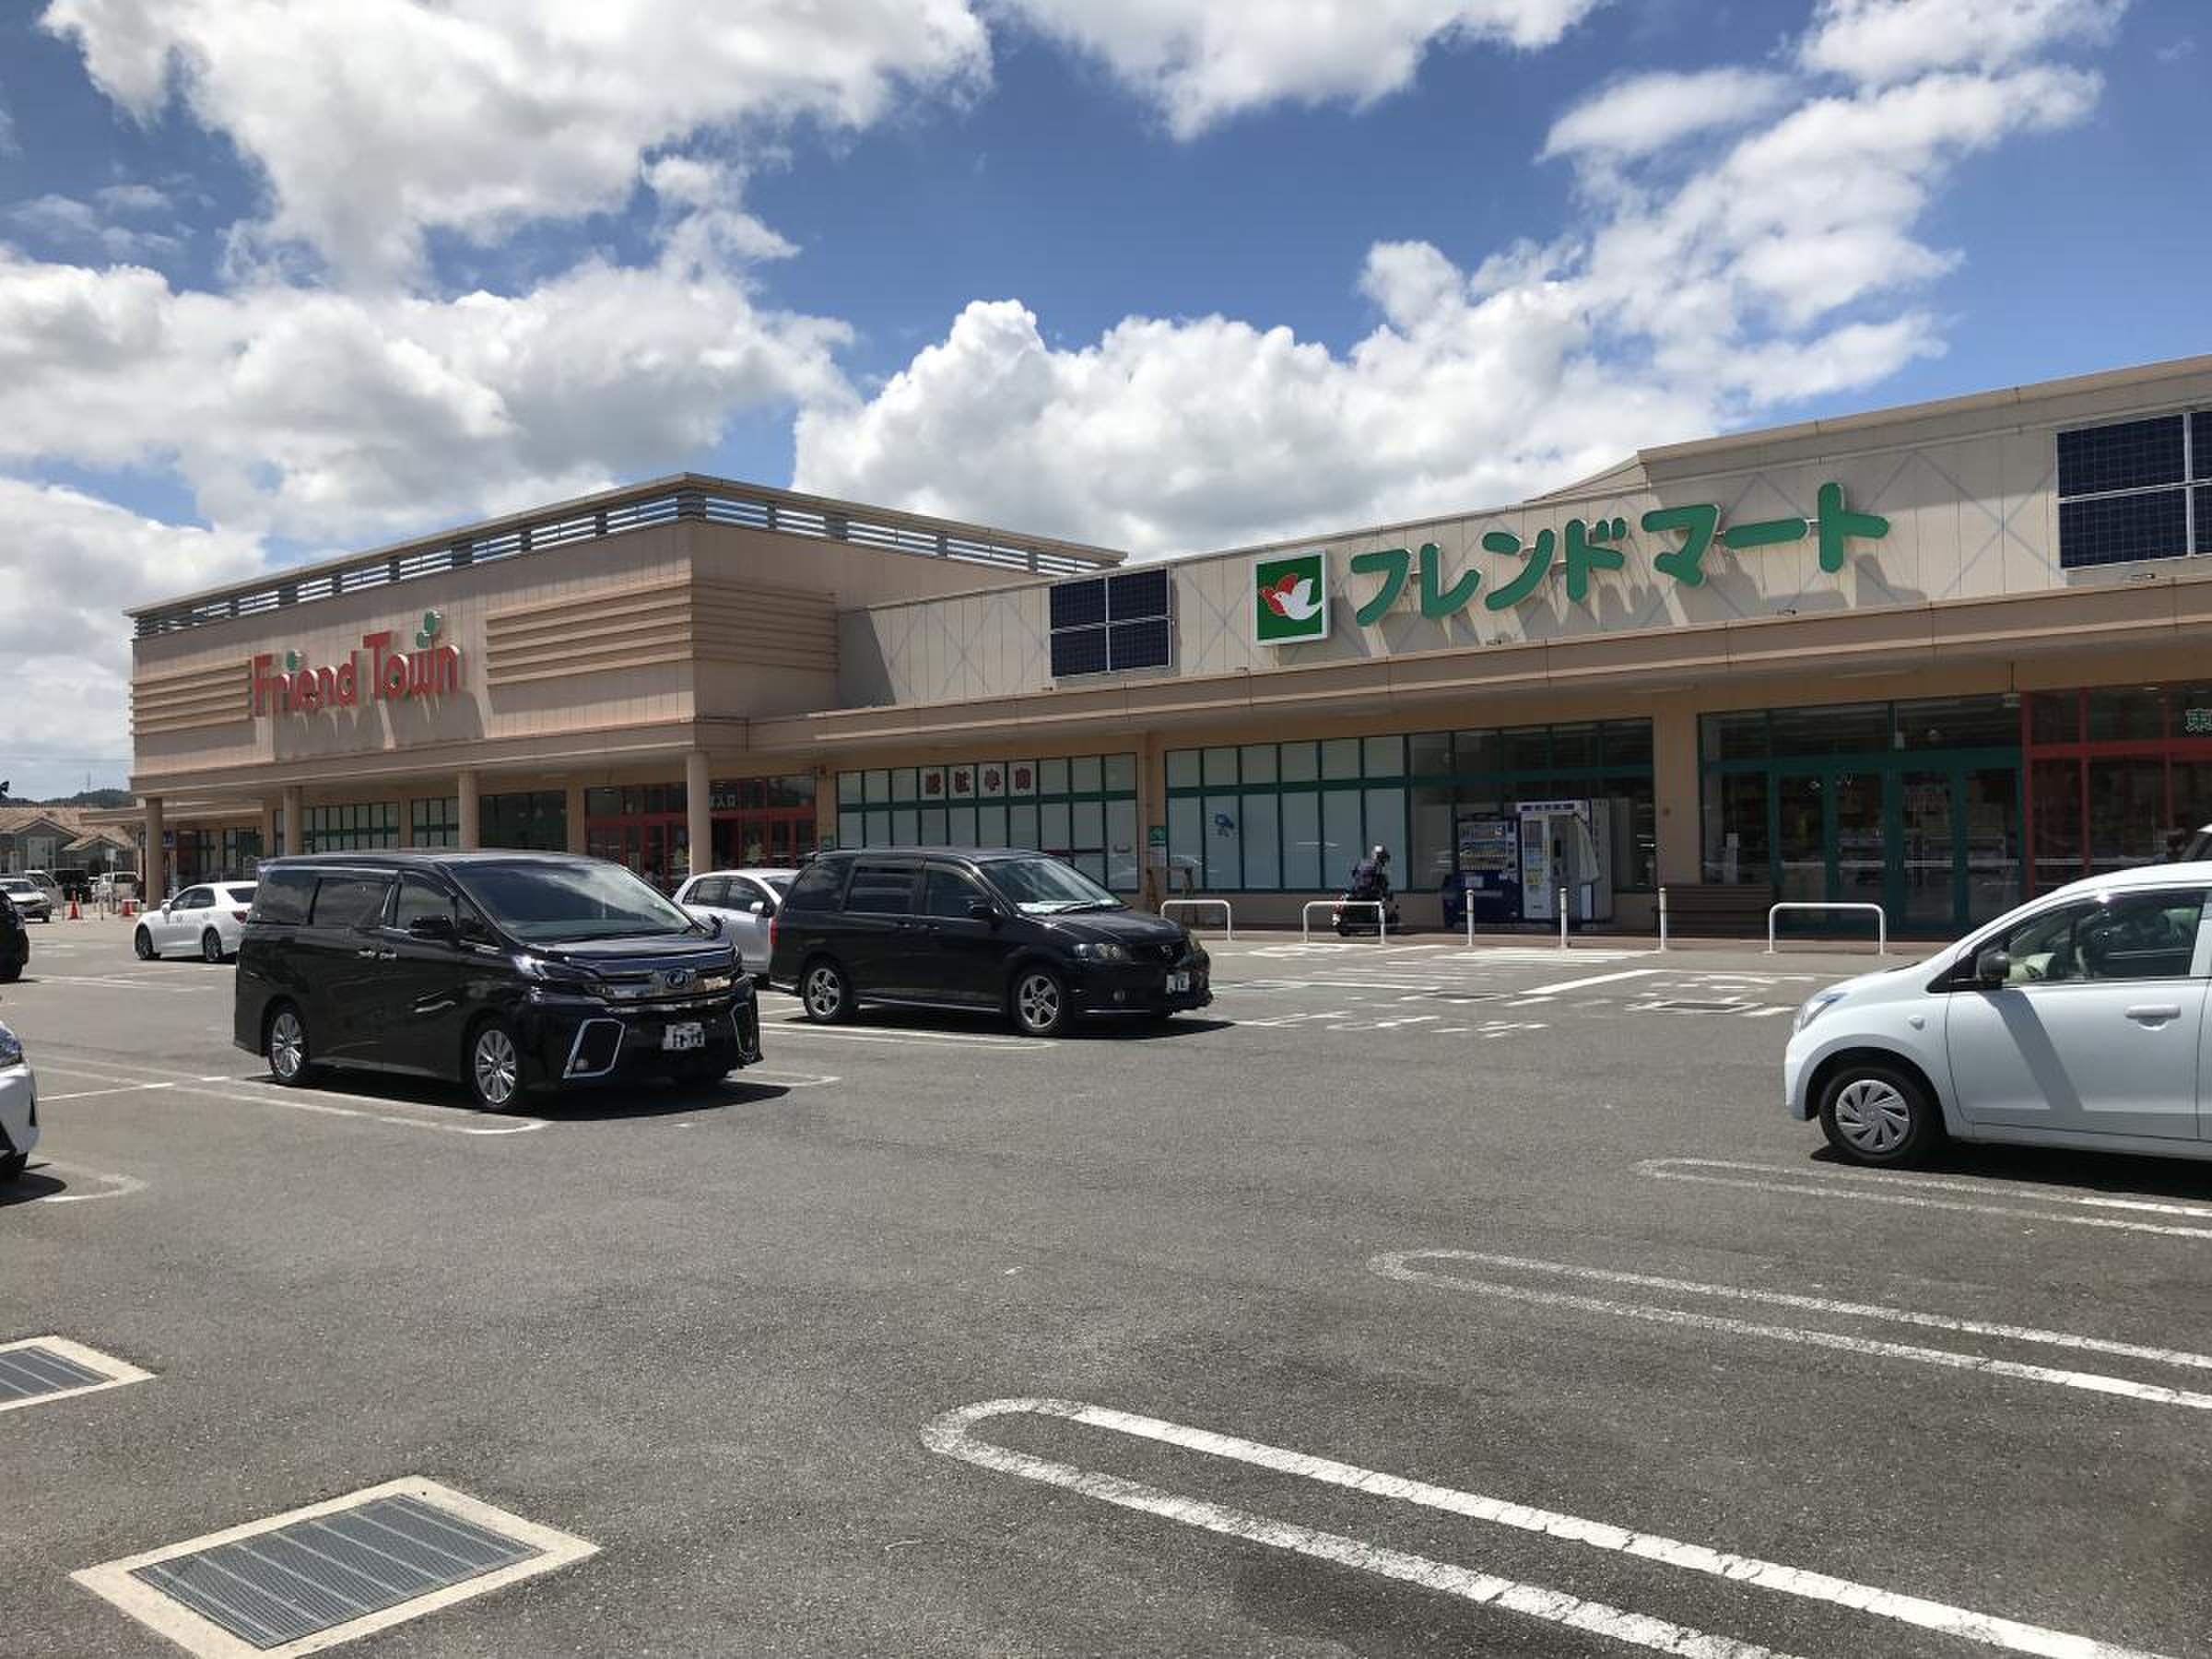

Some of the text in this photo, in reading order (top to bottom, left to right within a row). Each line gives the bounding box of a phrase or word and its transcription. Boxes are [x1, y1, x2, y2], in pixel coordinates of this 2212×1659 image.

[1350, 481, 1890, 628] フレンドマート
[253, 627, 460, 717] Friend Town
